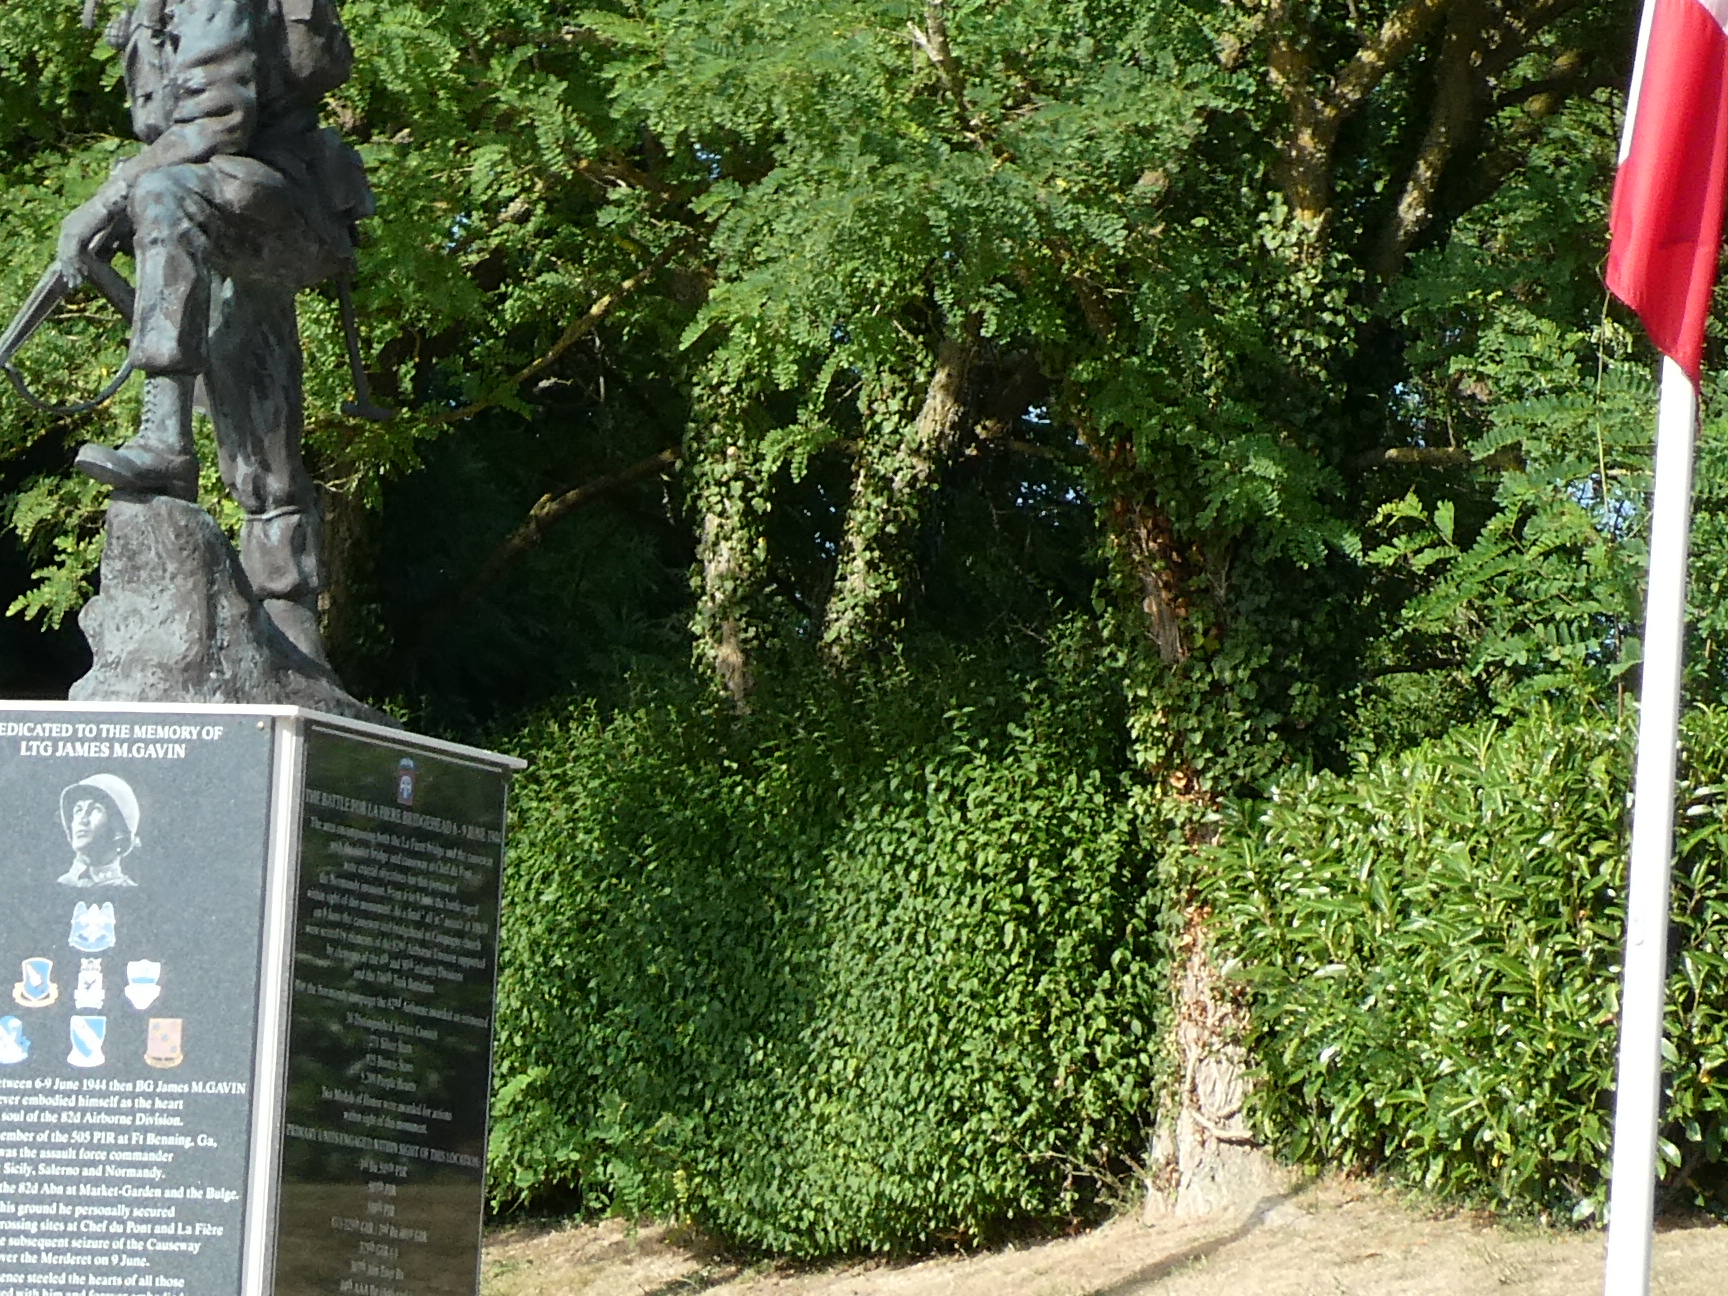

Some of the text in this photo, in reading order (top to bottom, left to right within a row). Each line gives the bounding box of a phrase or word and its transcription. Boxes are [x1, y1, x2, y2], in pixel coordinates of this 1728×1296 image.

[75, 723, 96, 738] TO
[100, 723, 130, 738] THE
[133, 724, 200, 740] MEMORY
[201, 725, 222, 740] OF
[20, 740, 52, 756] LTG
[55, 741, 108, 757] JAMES
[53, 1077, 79, 1090] June
[82, 1078, 105, 1091] 1944
[109, 1079, 132, 1092] then
[136, 1079, 153, 1093] BG
[156, 1080, 188, 1093] James
[22, 1093, 74, 1107] embodied
[78, 1094, 118, 1108] himself
[120, 1098, 132, 1108] as
[135, 1096, 152, 1109] the
[155, 1096, 183, 1109] heart
[1, 1109, 23, 1122] soul
[26, 1109, 38, 1122] of
[41, 1110, 57, 1123] the
[83, 1111, 132, 1125] Airborne
[36, 1129, 49, 1142] of
[51, 1130, 68, 1143] the
[117, 1133, 128, 1144] at
[19, 1146, 36, 1158] the
[40, 1146, 75, 1159] assault
[78, 1147, 106, 1161] force
[109, 1148, 173, 1162] commander
[38, 1162, 79, 1176] Salerno
[82, 1164, 102, 1177] and
[65, 1185, 76, 1195] at
[79, 1183, 161, 1198] Market-Garden
[164, 1185, 184, 1198] and
[186, 1186, 202, 1199] the
[17, 1201, 56, 1218] ground
[59, 1202, 71, 1215] he
[74, 1202, 129, 1219] personally
[132, 1204, 174, 1218] secured
[40, 1218, 64, 1231] sites
[67, 1221, 77, 1232] at
[80, 1219, 106, 1232] Chef
[109, 1220, 123, 1233] du
[126, 1220, 151, 1234] Pont
[154, 1221, 174, 1234] and
[177, 1222, 191, 1235] La
[8, 1234, 68, 1251] subsequent
[71, 1236, 109, 1249] seizure
[112, 1237, 125, 1249] of
[127, 1237, 143, 1250] the
[146, 1237, 201, 1254] Causeway
[20, 1251, 37, 1264] the
[94, 1256, 108, 1265] on
[111, 1253, 118, 1265] 9
[27, 1271, 65, 1285] steeled
[68, 1272, 85, 1285] the
[88, 1273, 122, 1286] hearts
[124, 1273, 137, 1286] of
[138, 1274, 152, 1287] all
[155, 1274, 184, 1288] those
